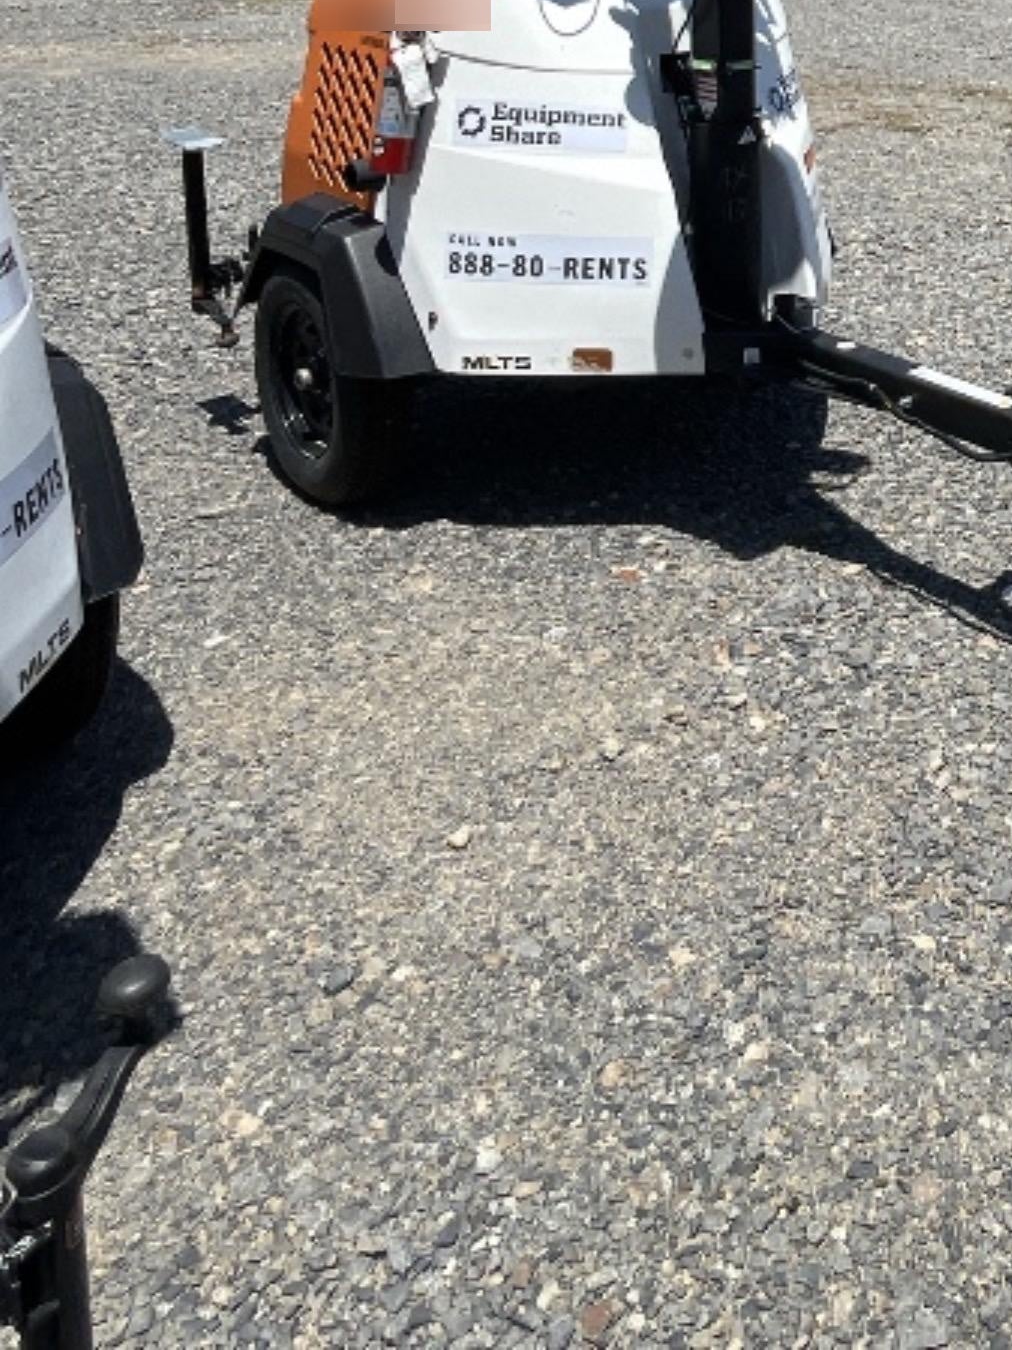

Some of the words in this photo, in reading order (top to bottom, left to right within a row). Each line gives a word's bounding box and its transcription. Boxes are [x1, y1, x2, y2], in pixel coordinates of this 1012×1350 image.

[491, 102, 625, 127] Equipment
[490, 126, 562, 145] Share
[462, 356, 532, 370] MLTS
